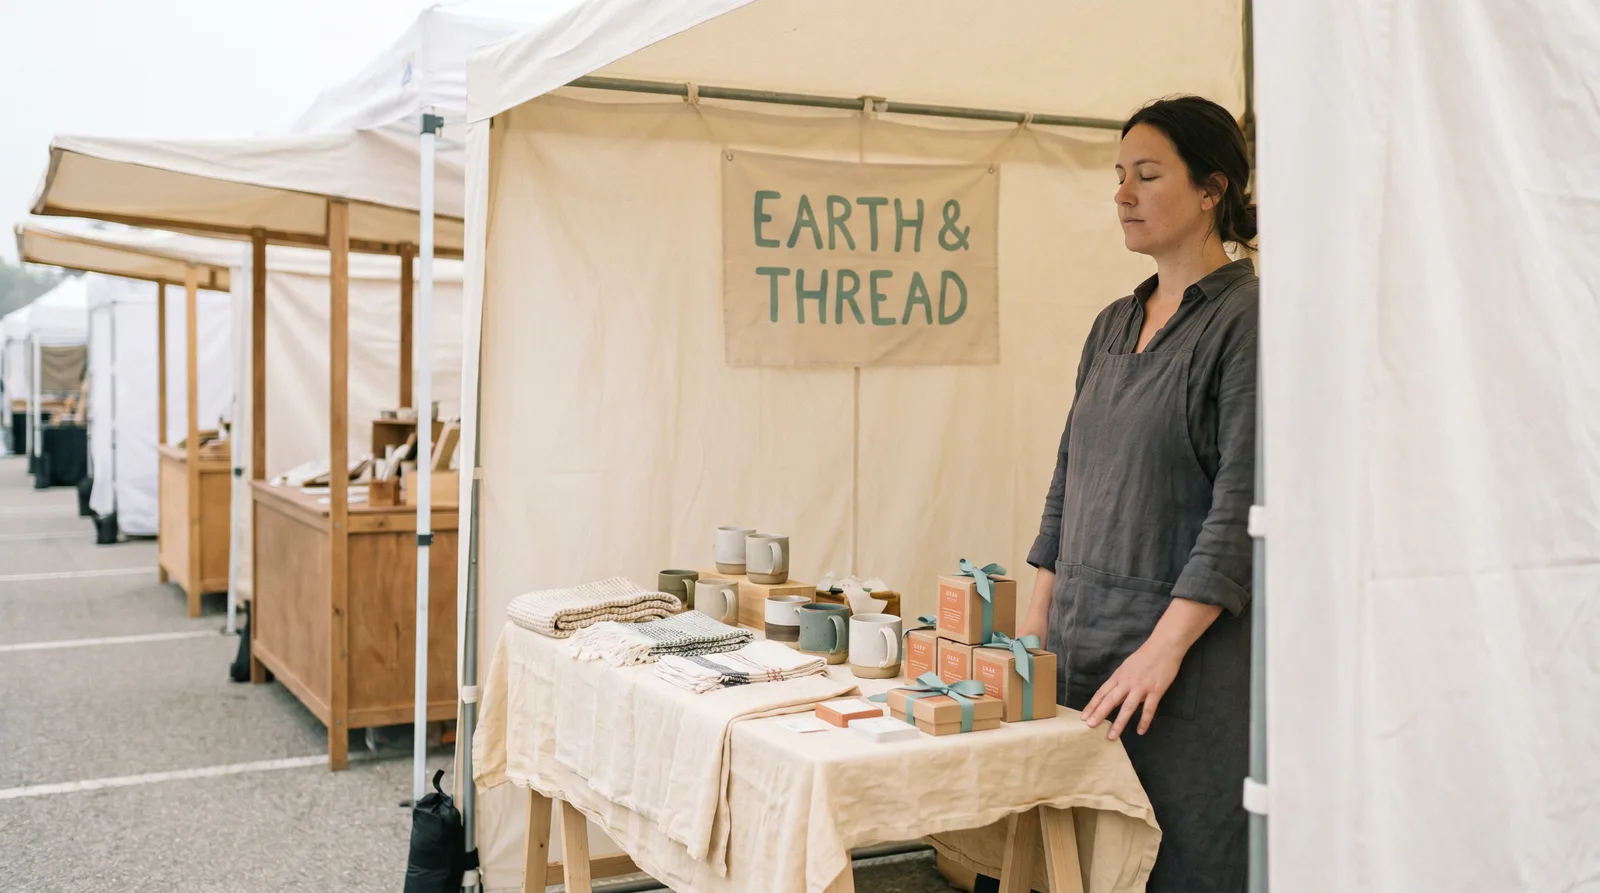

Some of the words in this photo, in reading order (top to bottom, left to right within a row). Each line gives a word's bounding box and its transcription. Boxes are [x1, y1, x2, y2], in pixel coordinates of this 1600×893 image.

[754, 190, 924, 252] EARTH
[938, 199, 970, 251] &
[755, 267, 968, 325] THREAD
